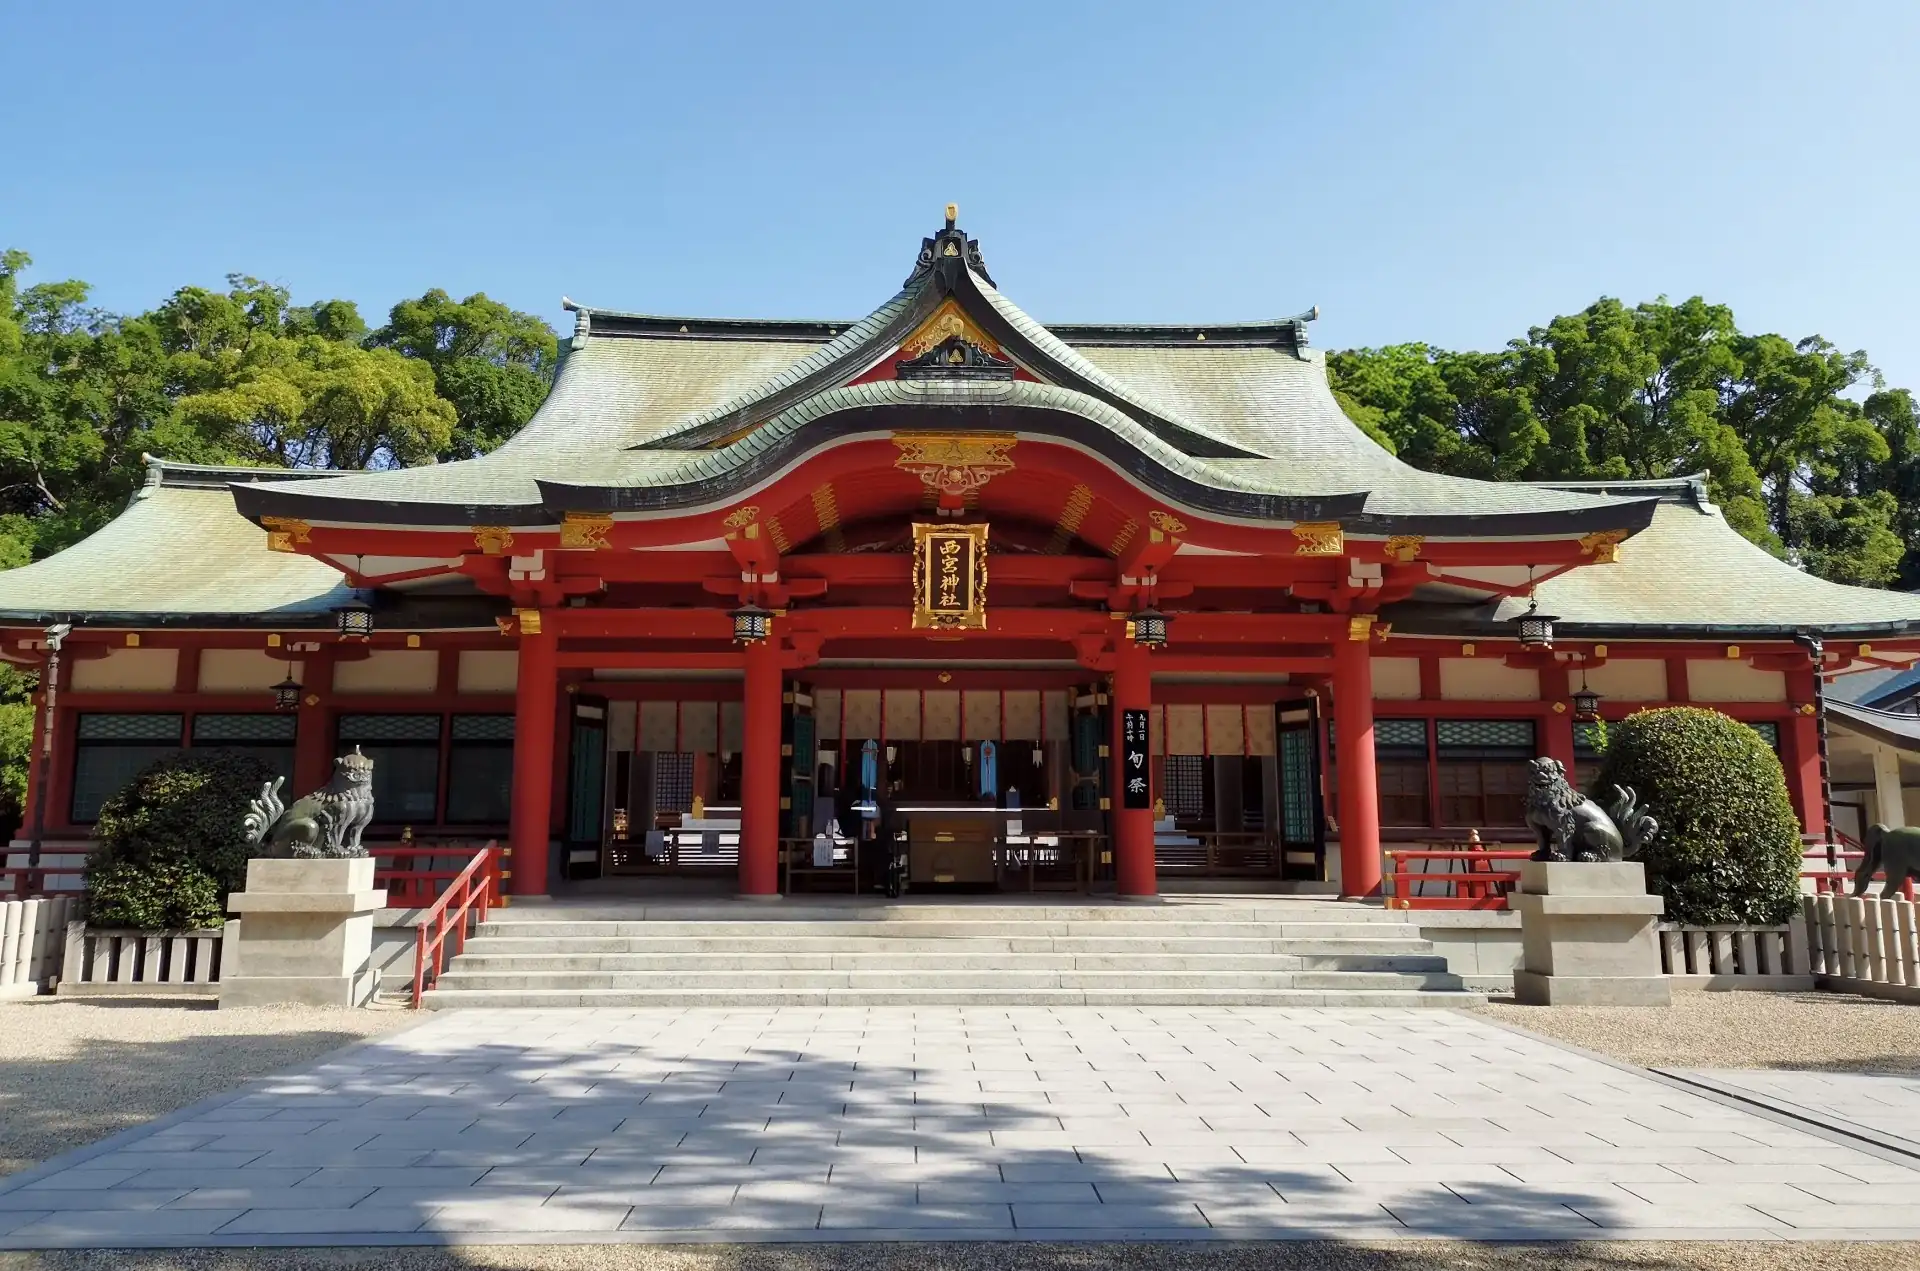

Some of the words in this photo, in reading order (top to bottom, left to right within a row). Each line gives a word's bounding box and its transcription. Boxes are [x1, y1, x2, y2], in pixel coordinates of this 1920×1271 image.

[939, 540, 961, 606] 西宮神社
[1125, 713, 1135, 743] 午前十時
[1138, 713, 1146, 741] 九月一日
[1127, 750, 1147, 794] 旬祭
